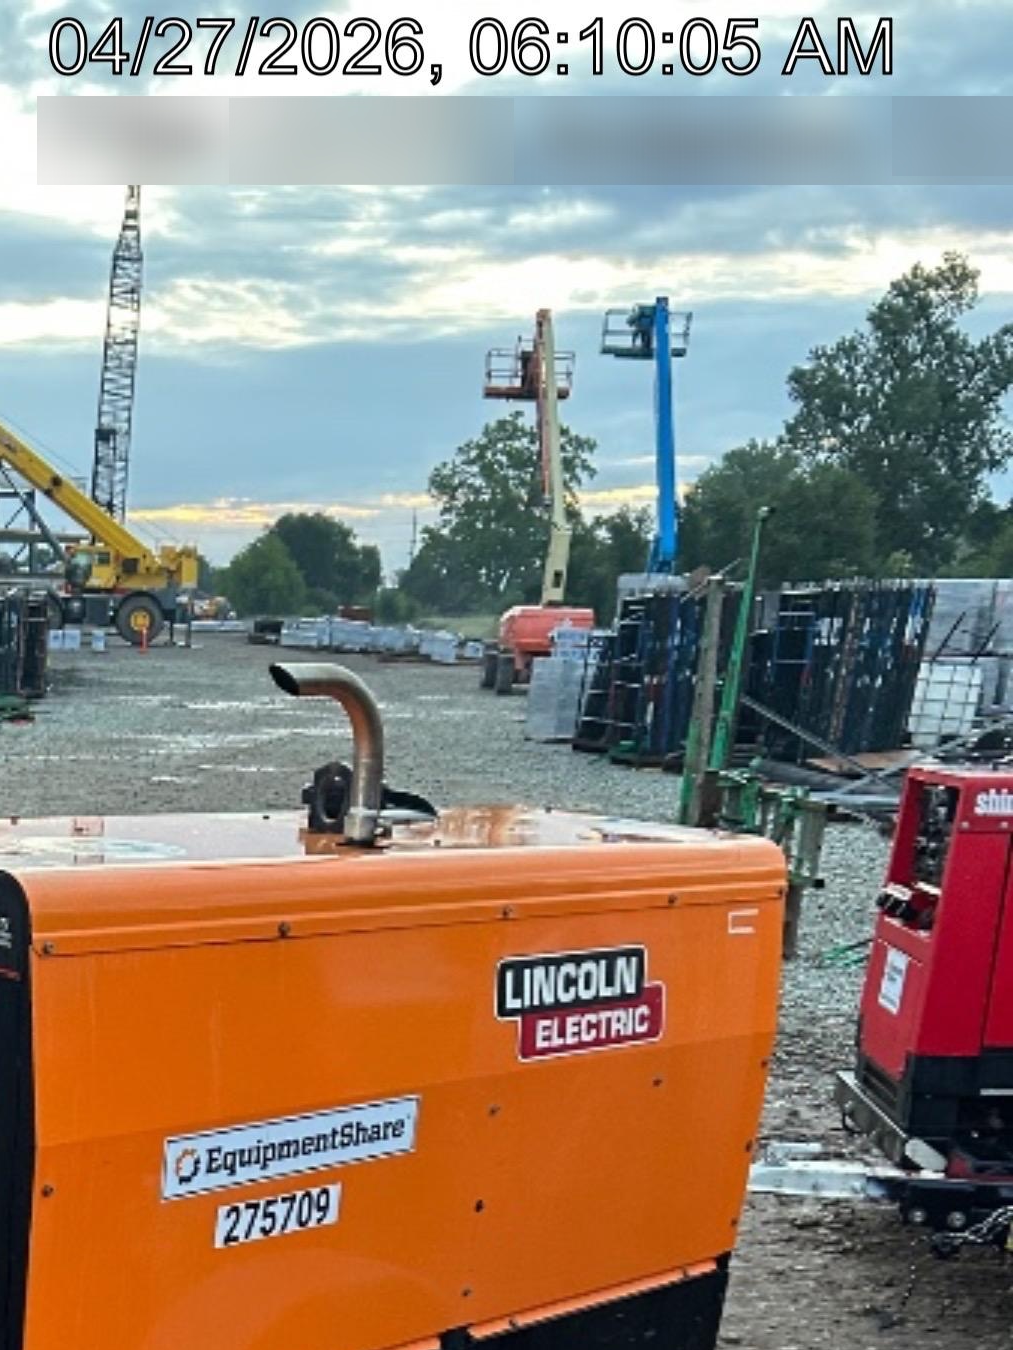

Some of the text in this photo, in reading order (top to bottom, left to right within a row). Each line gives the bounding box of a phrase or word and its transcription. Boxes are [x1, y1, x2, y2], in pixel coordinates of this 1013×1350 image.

[504, 956, 639, 1010] LINCOLN
[534, 1004, 650, 1052] ELECTRIC
[205, 1117, 406, 1177] EquipmentShare
[222, 1187, 331, 1246] 275709
